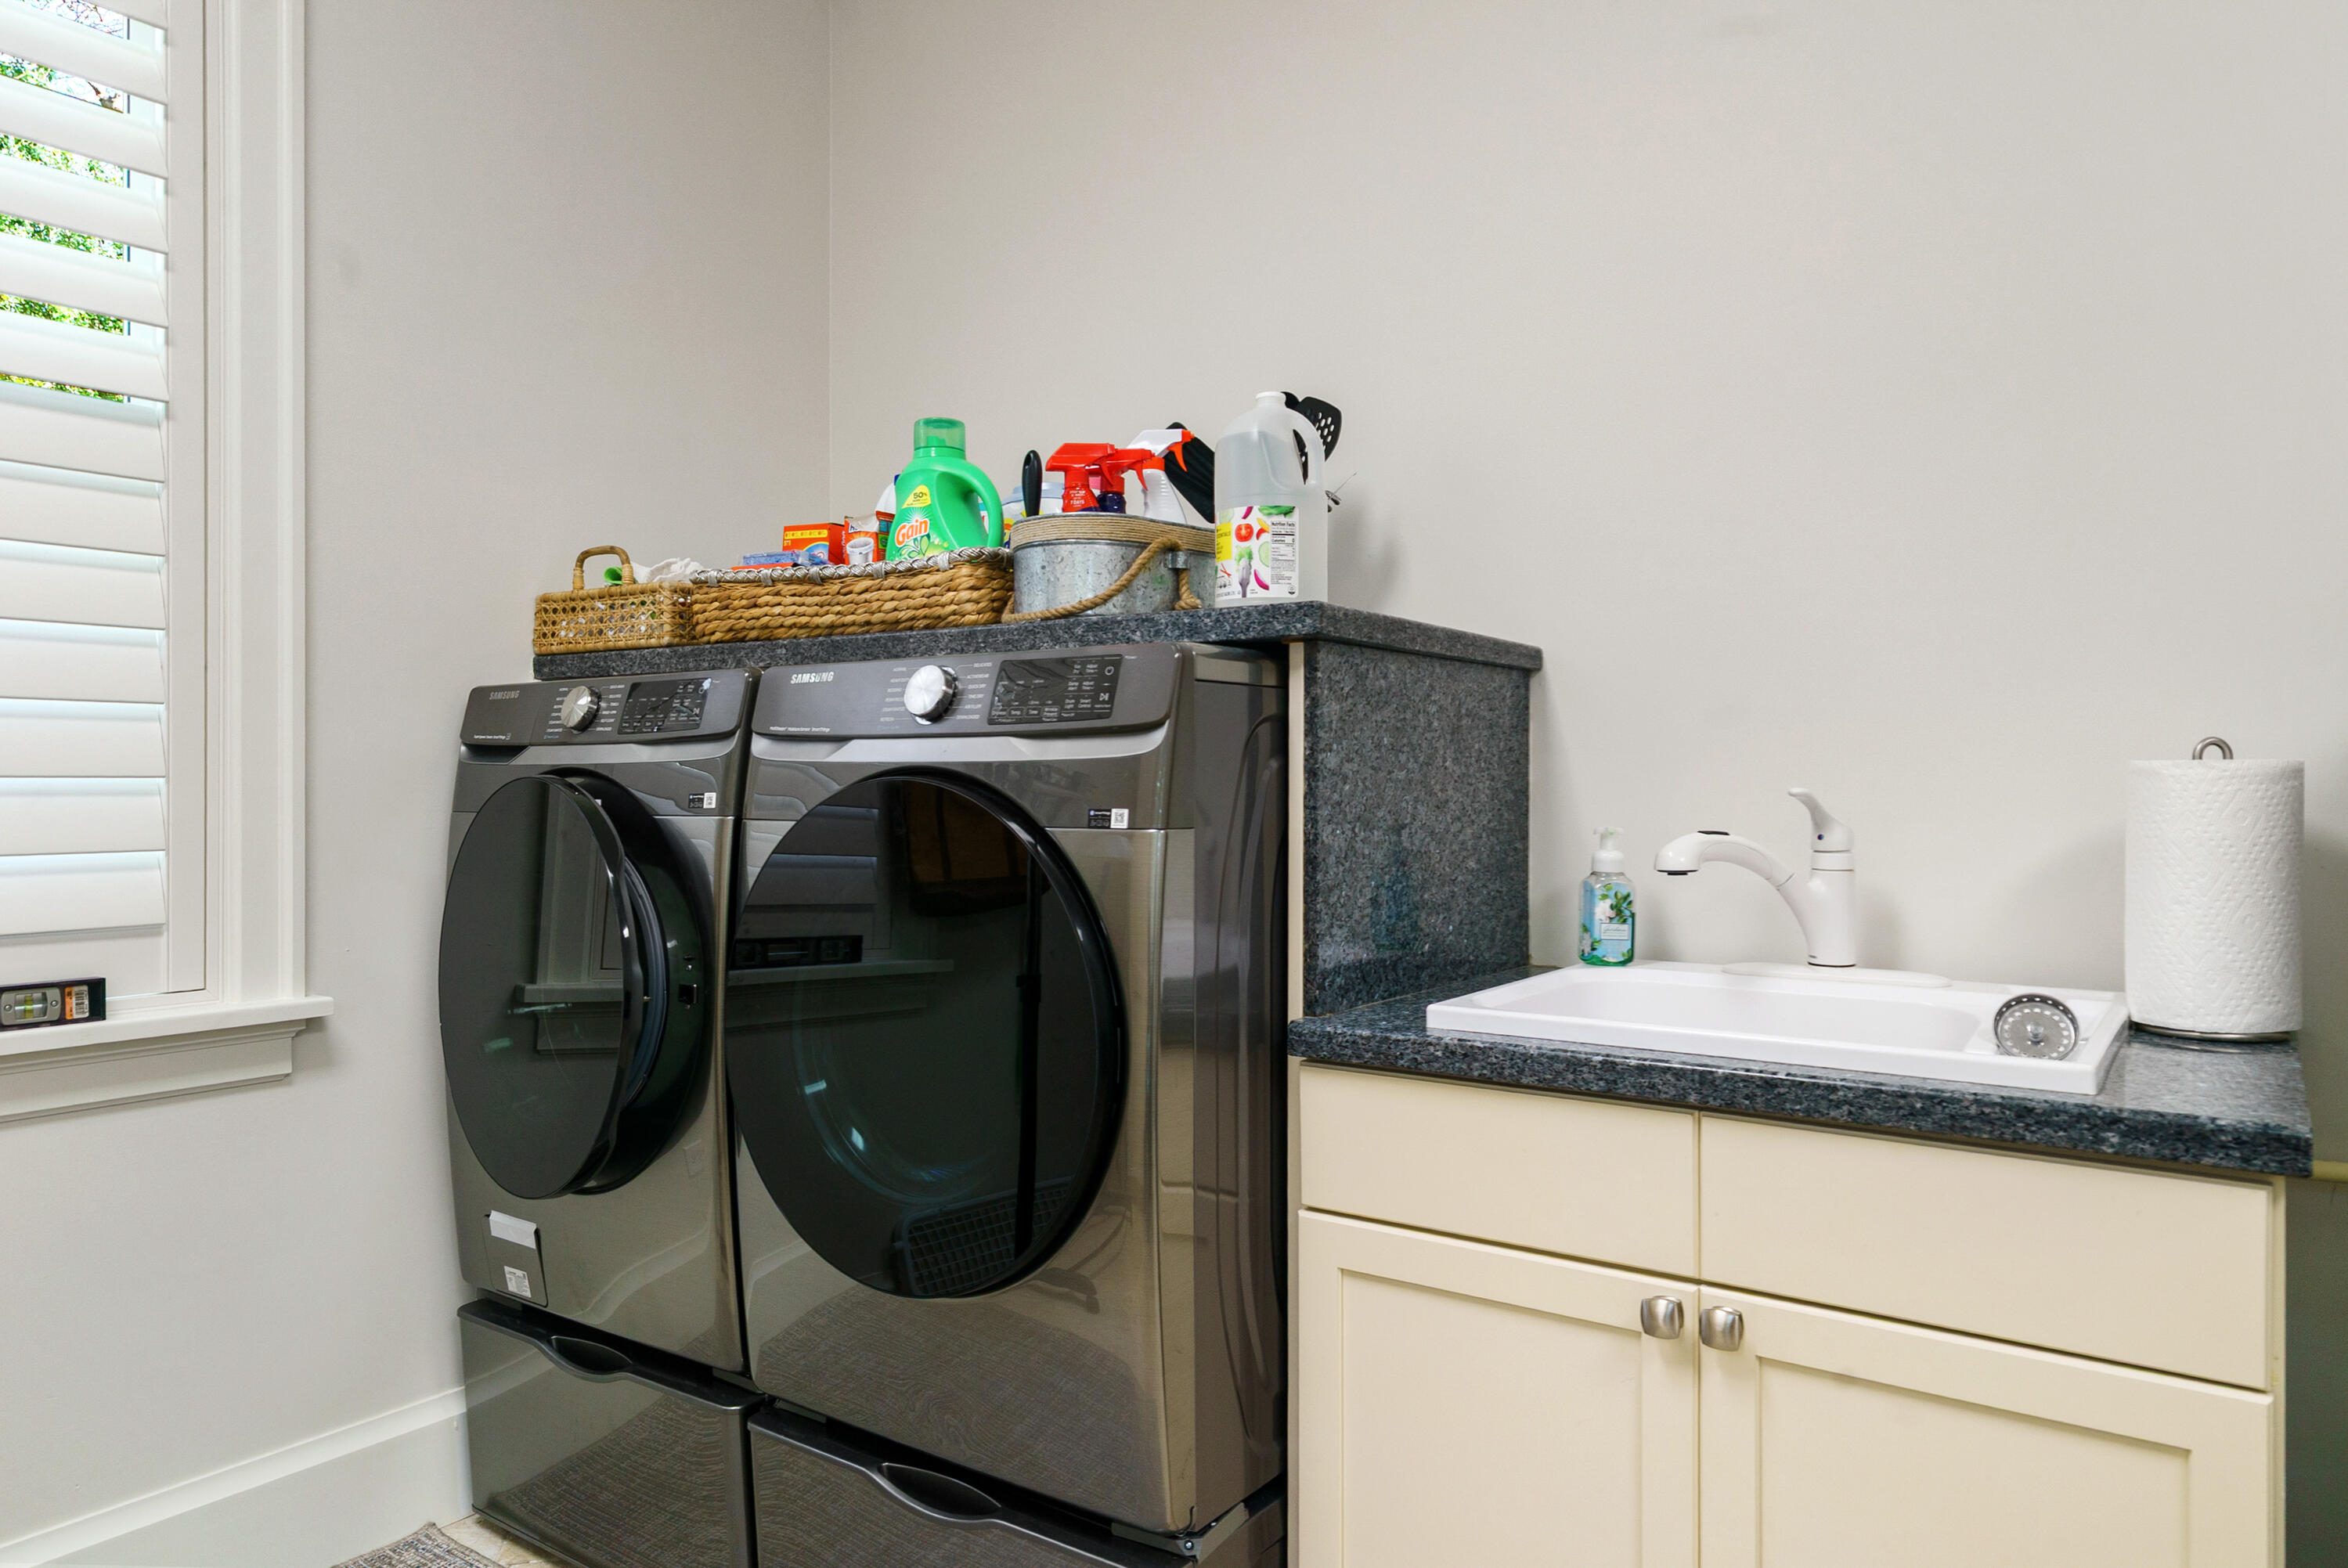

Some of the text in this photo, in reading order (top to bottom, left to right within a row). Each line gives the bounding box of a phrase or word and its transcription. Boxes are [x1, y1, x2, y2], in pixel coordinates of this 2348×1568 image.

[895, 518, 929, 546] Gain
[790, 672, 835, 684] SAMSUNG
[489, 690, 520, 700] SAMSUNG
